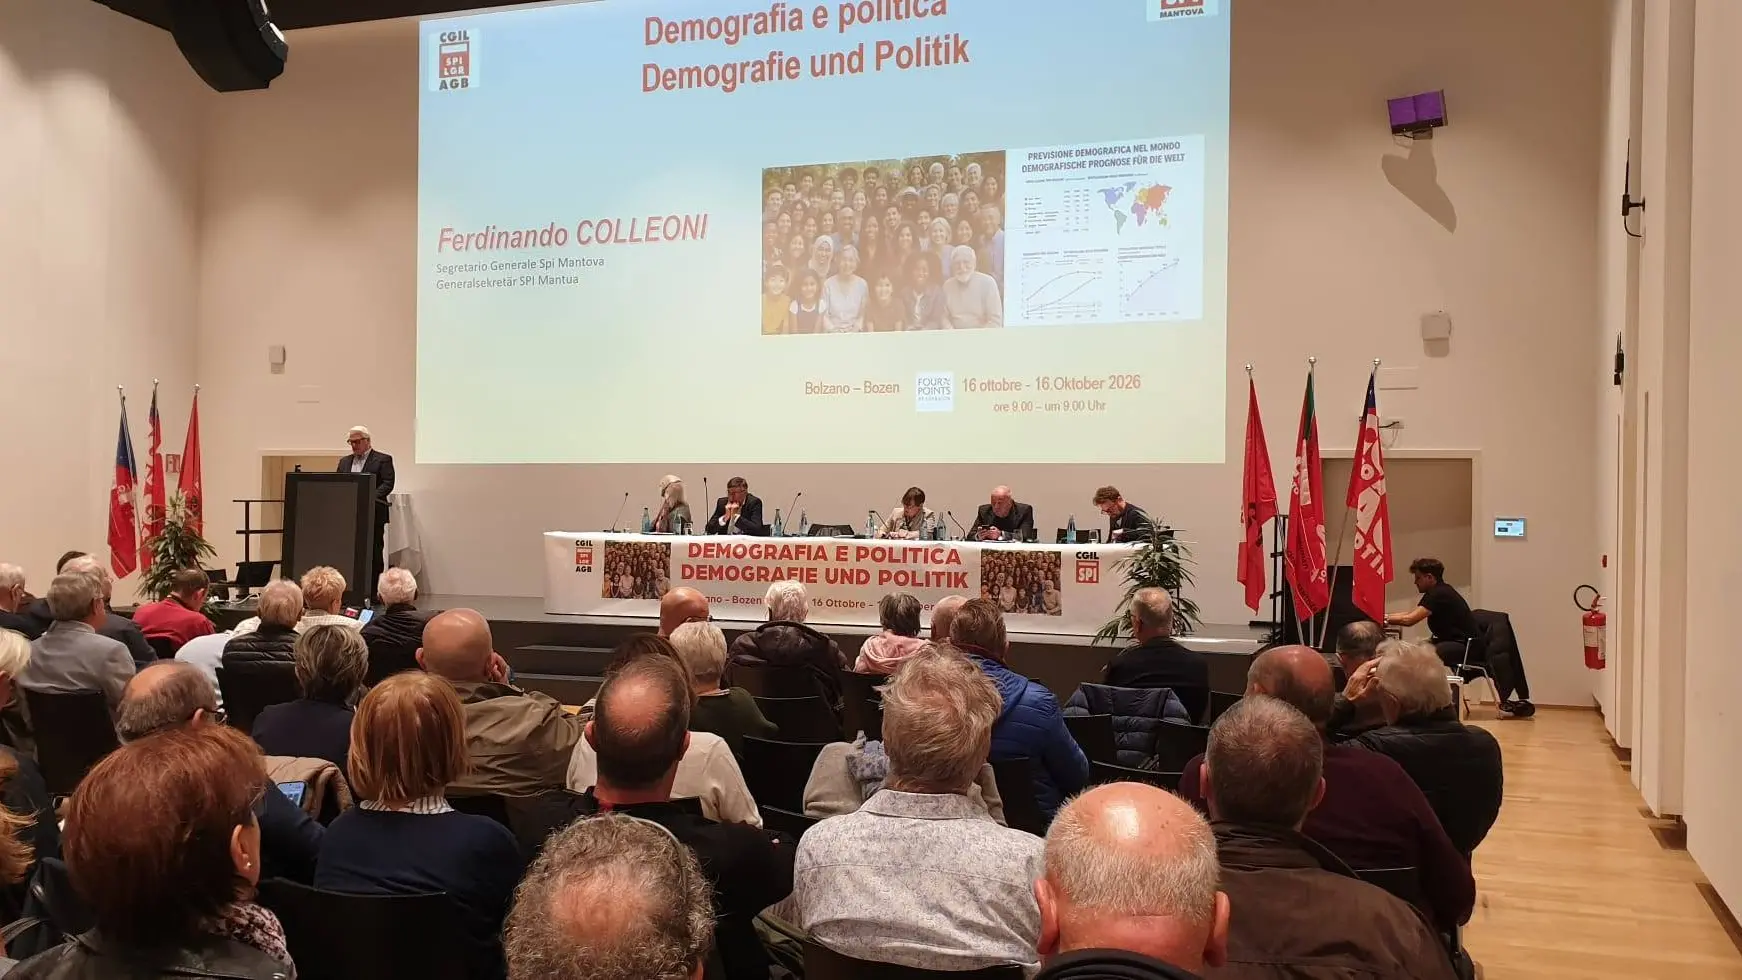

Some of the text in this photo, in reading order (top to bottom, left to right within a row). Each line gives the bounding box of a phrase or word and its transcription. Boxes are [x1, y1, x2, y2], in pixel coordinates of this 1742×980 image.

[1160, 8, 1204, 18] MANTOVA
[645, 0, 947, 45] Demografia e politica
[440, 30, 469, 42] CGIL
[446, 56, 463, 66] SPI
[642, 33, 970, 93] Demografie und Politik
[444, 66, 464, 76] LGR
[439, 78, 469, 90] AGB
[1028, 141, 1180, 161] PREVISIONE DEMOGRAFICA NEL MONDO
[1022, 153, 1185, 173] DEMOGRAFISCHE PROGNOSE FÜR DIE WELT
[438, 214, 708, 252] Ferdinando COLLEONI
[436, 257, 605, 275] Segretario Generale Spi Mantova
[436, 275, 579, 290] Generalsekretär SPI Mantua
[805, 381, 850, 395] Bolzano
[863, 381, 900, 394] Bozen
[918, 387, 951, 395] POINTS
[962, 378, 976, 392] 16
[979, 378, 1022, 391] ottobre
[1109, 375, 1141, 390] 2026
[994, 403, 1009, 412] ore
[1012, 401, 1033, 412] 9.00
[1045, 403, 1060, 411] um
[1064, 401, 1085, 411] 9.00
[1087, 400, 1106, 411] Uhr
[688, 543, 962, 565] DEMOGRAFIA E POLITICA
[1076, 552, 1100, 560] CGIL
[681, 564, 969, 588] DEMOGRAFIE UND POLITIK
[1079, 567, 1097, 582] SPI
[732, 595, 762, 605] Bozen
[812, 598, 823, 607] 16
[825, 599, 866, 609] Ottobre
